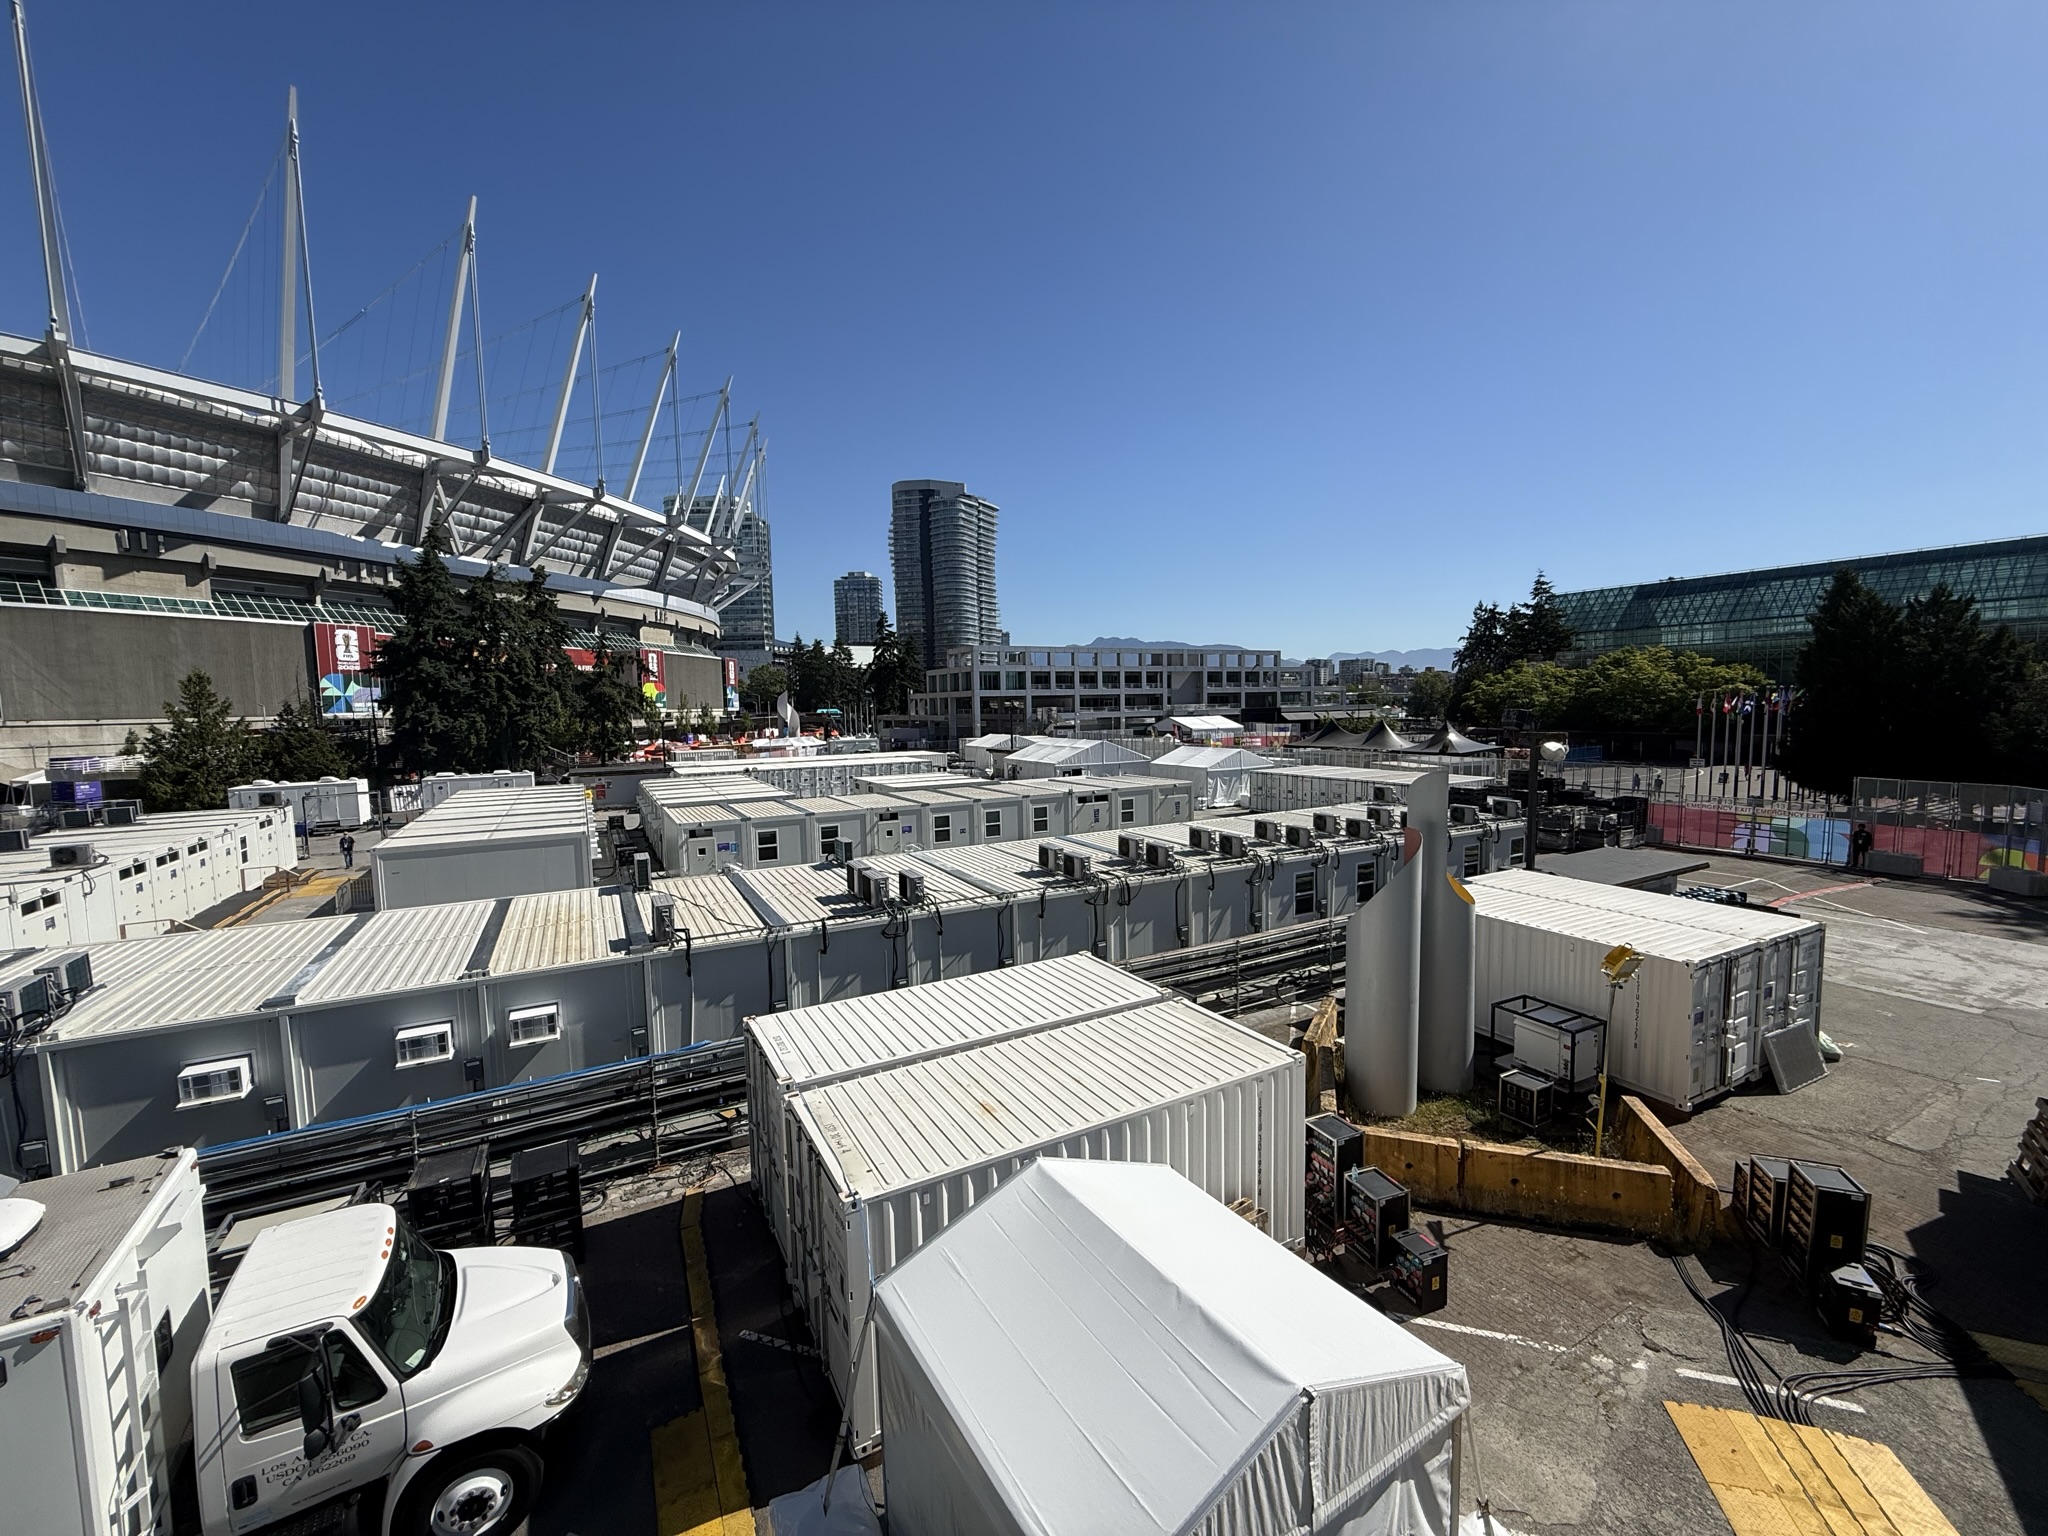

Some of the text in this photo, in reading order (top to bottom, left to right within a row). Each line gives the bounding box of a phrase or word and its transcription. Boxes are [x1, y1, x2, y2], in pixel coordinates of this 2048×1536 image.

[1686, 802, 1733, 811] EMERGENCY
[1756, 808, 1804, 817] EMERGENCY
[261, 1461, 287, 1476] LOS
[266, 1460, 315, 1484] USDOT
[320, 1439, 370, 1463] 556090
[282, 1453, 356, 1487] CA 062209
